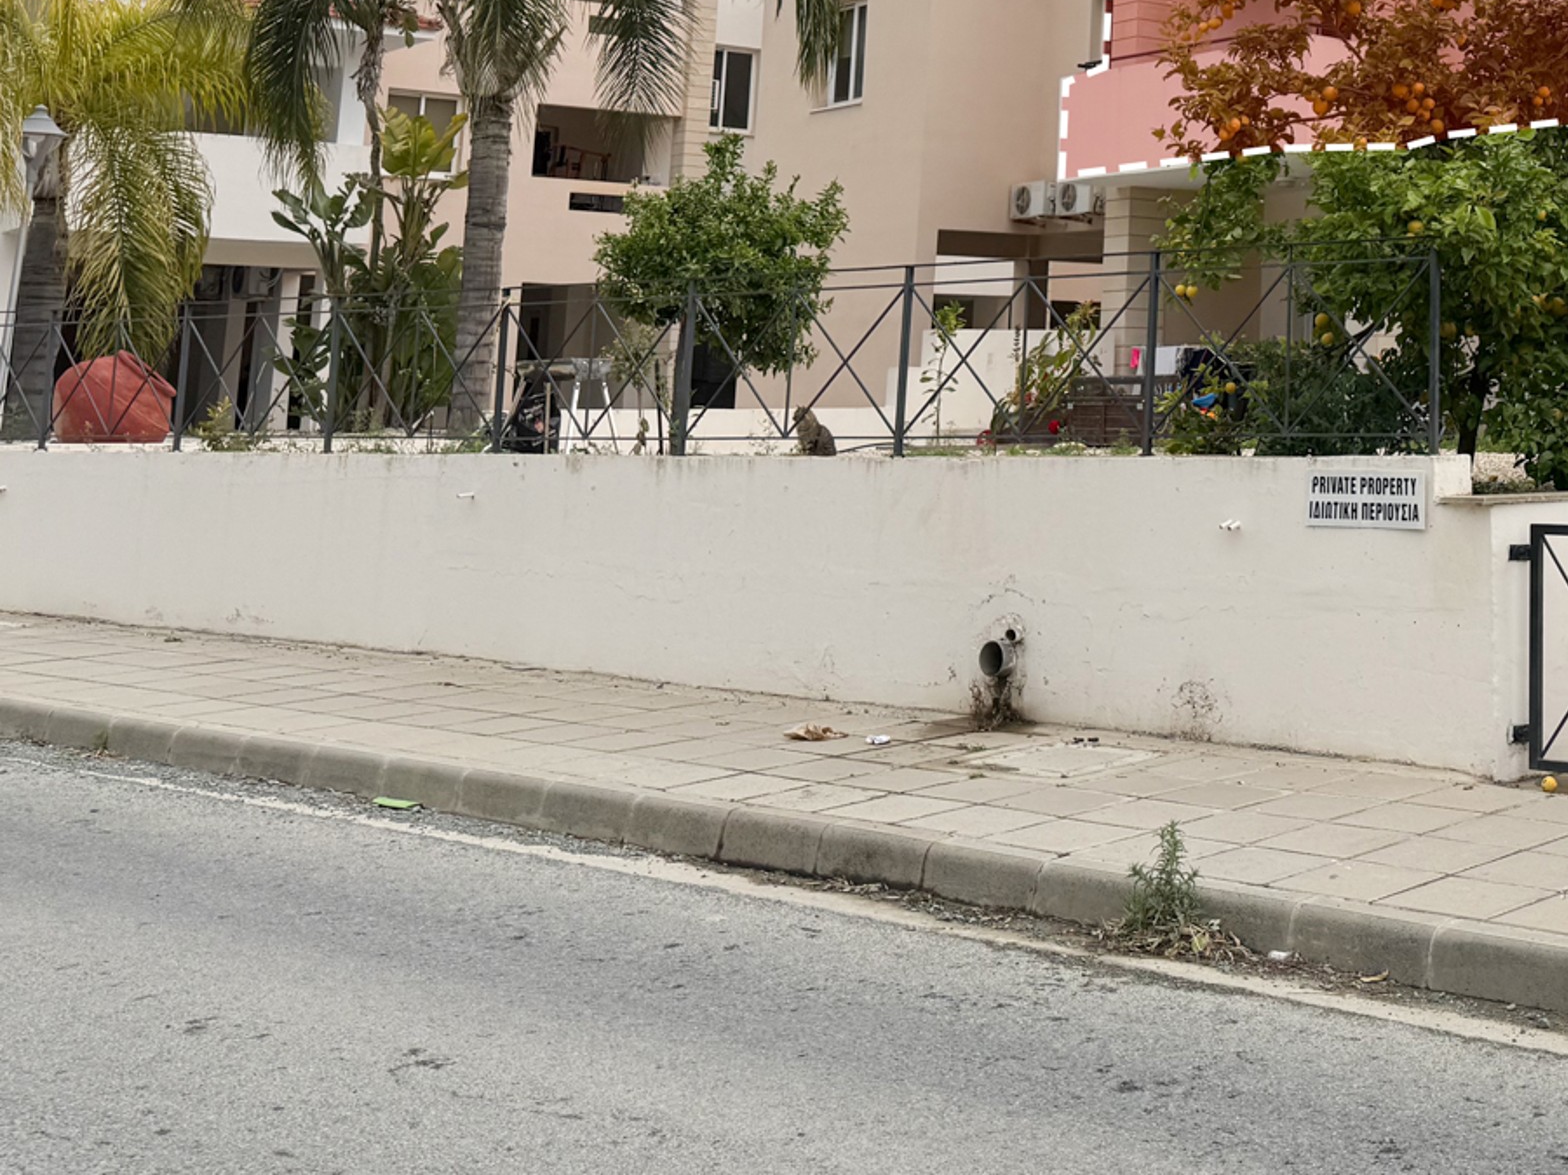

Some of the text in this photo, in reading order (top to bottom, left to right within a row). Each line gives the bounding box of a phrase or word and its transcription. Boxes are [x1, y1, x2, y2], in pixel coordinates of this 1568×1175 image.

[1311, 475, 1417, 497] PRIVATE PROPERTY
[1308, 500, 1420, 522] ΙΔΙΩΤΙΚΗ ΠΕΡΙΟΥΣΙΑ
